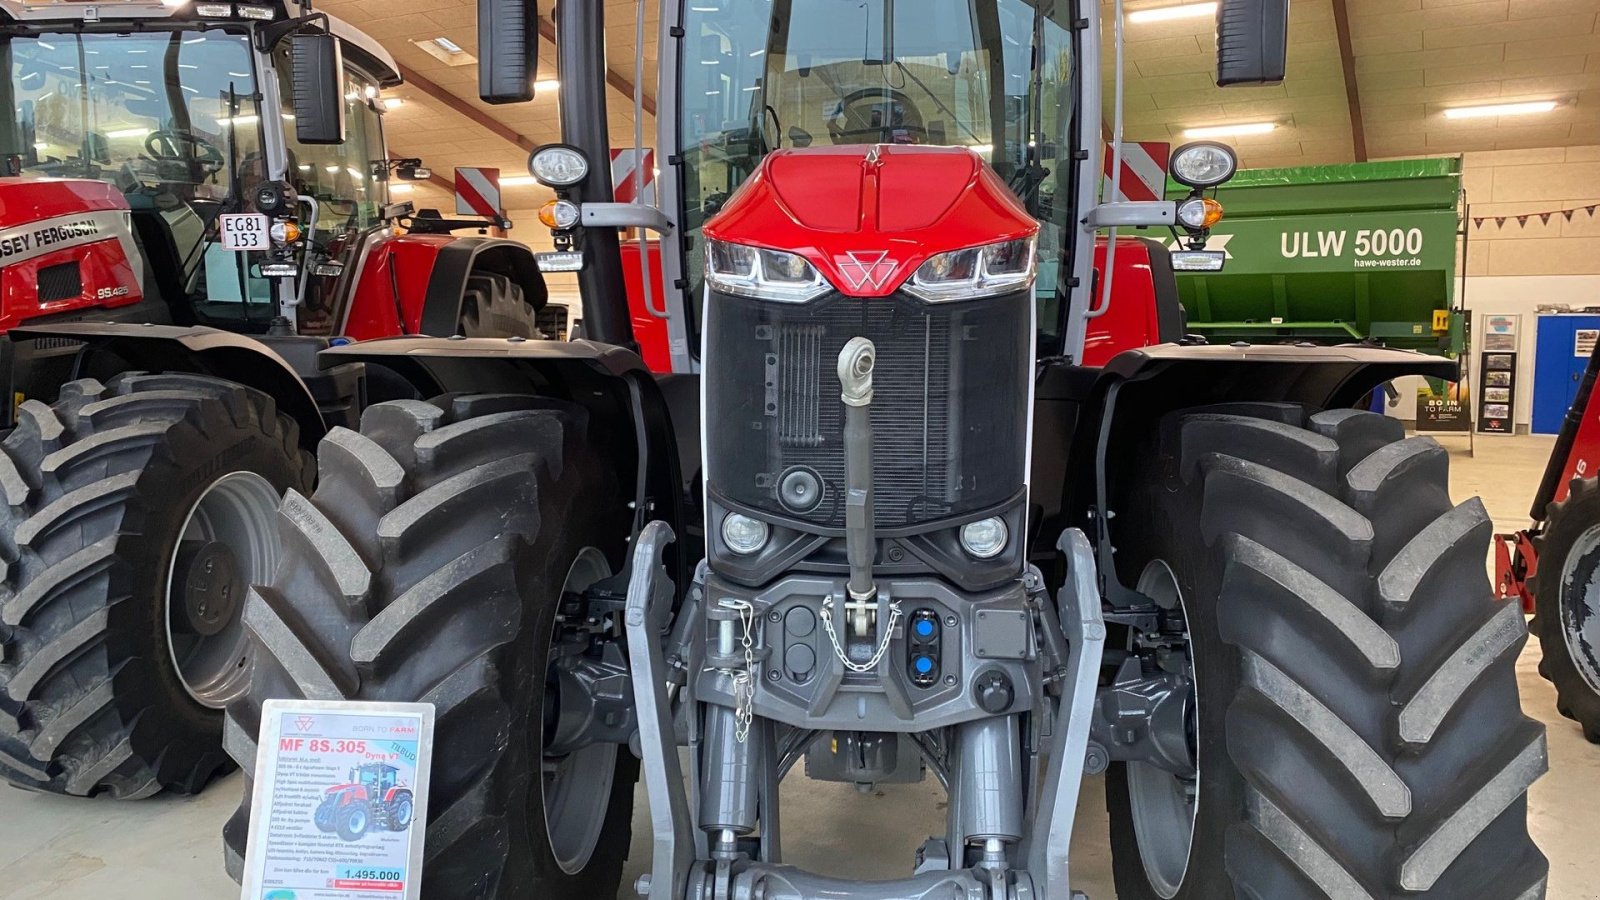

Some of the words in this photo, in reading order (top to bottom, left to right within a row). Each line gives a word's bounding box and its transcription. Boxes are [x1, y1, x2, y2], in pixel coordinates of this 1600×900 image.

[225, 217, 261, 231] EG81
[0, 234, 29, 258] SEY
[34, 219, 98, 248] FERGUSON
[233, 233, 258, 247] 153
[1281, 230, 1346, 258] ULW
[1354, 227, 1423, 256] 5000
[1354, 257, 1421, 267] hawe-wester.de
[97, 285, 129, 299] 9S.425
[352, 725, 374, 733] BORN
[279, 738, 304, 752] MF
[309, 739, 366, 754] 8S.305
[391, 741, 416, 761] TILBUD
[365, 752, 386, 760] Dyna
[389, 752, 400, 760] VT
[344, 869, 400, 881] 1.495.000
